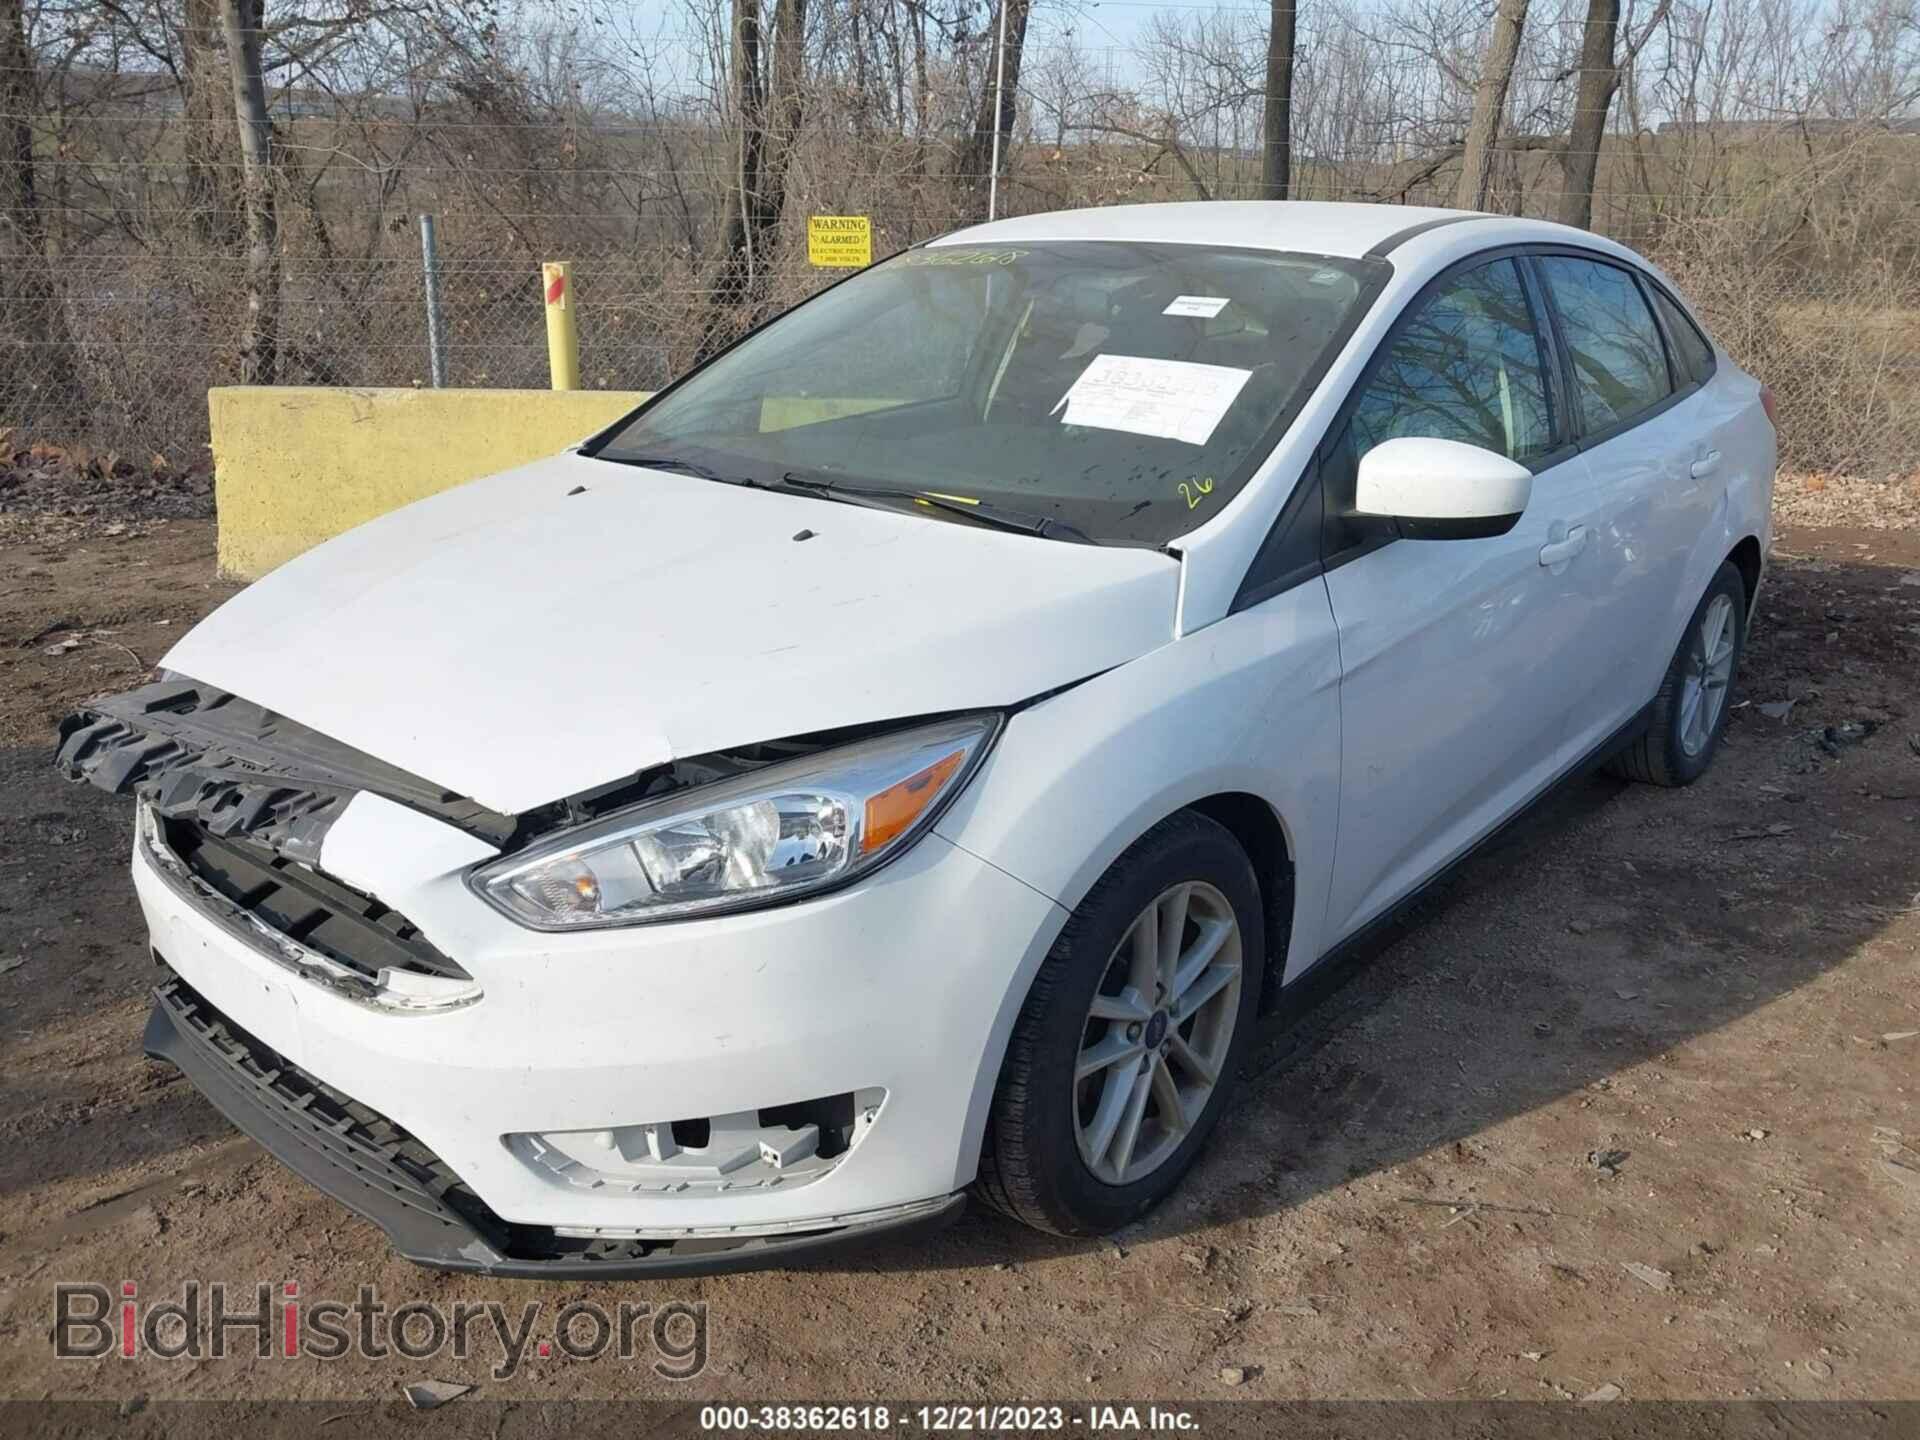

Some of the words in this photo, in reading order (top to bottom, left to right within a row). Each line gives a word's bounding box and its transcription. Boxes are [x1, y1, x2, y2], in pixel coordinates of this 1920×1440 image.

[813, 219, 866, 230] WARNING
[822, 235, 860, 244] ALARMED
[1178, 472, 1213, 509] 26
